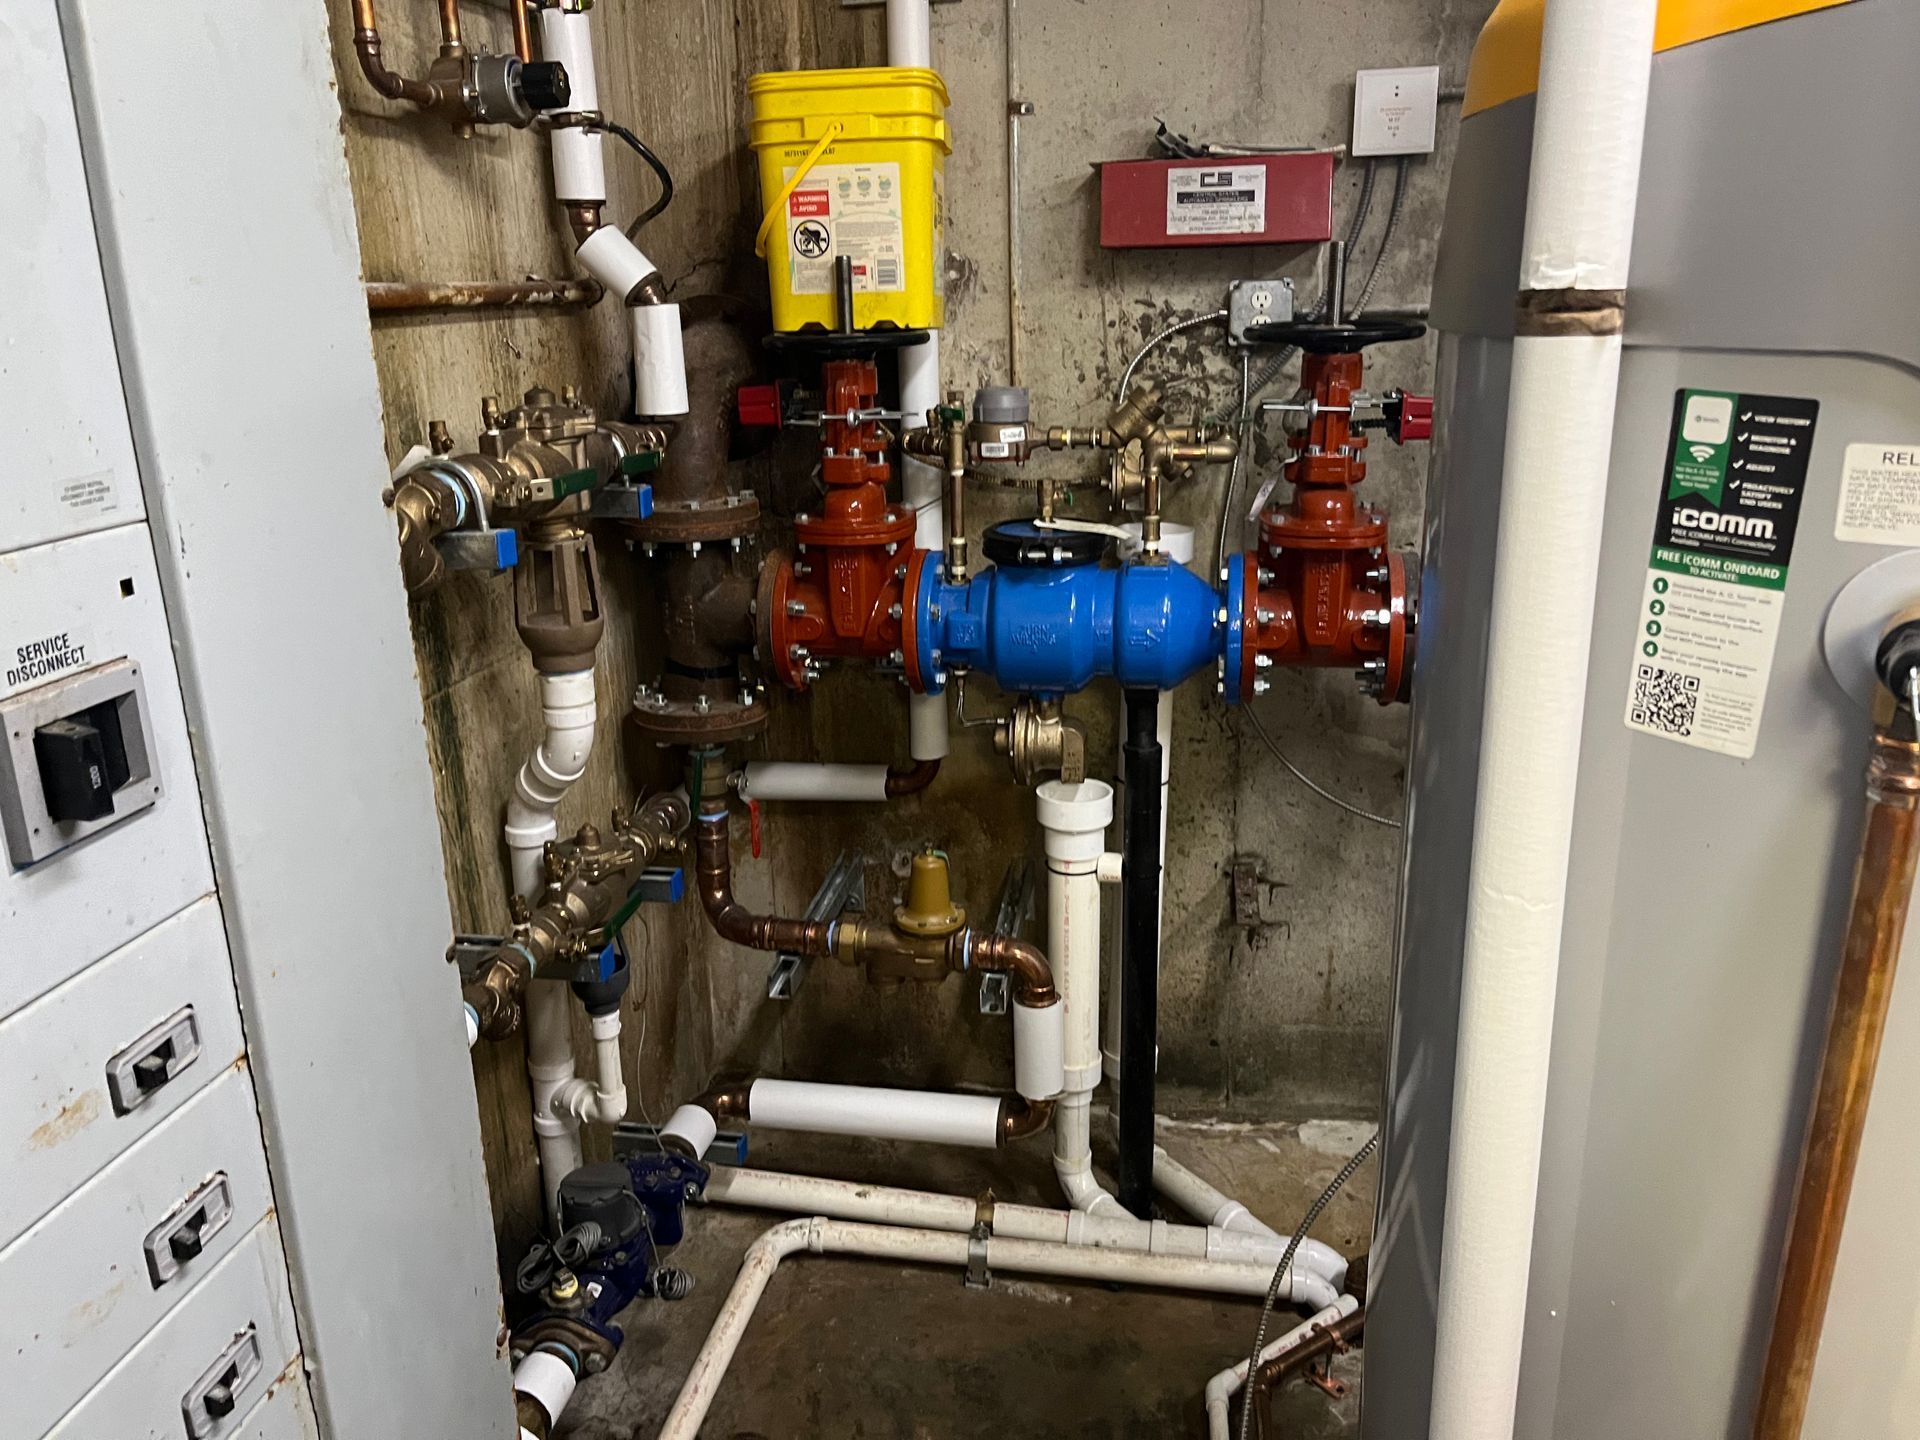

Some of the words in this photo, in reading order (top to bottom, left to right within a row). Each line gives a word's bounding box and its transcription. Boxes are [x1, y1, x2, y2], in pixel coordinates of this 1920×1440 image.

[1732, 538, 1776, 551] Connectivity
[1657, 550, 1680, 563] FREE
[1683, 554, 1720, 570] iCOMM
[1723, 561, 1779, 579] ONBOARD
[1657, 582, 1663, 590] 1
[1654, 603, 1660, 612] 2
[1650, 624, 1657, 633] 3
[17, 633, 70, 664] SERVICE
[1647, 645, 1654, 653] 4
[7, 646, 86, 686] DISCONNECT
